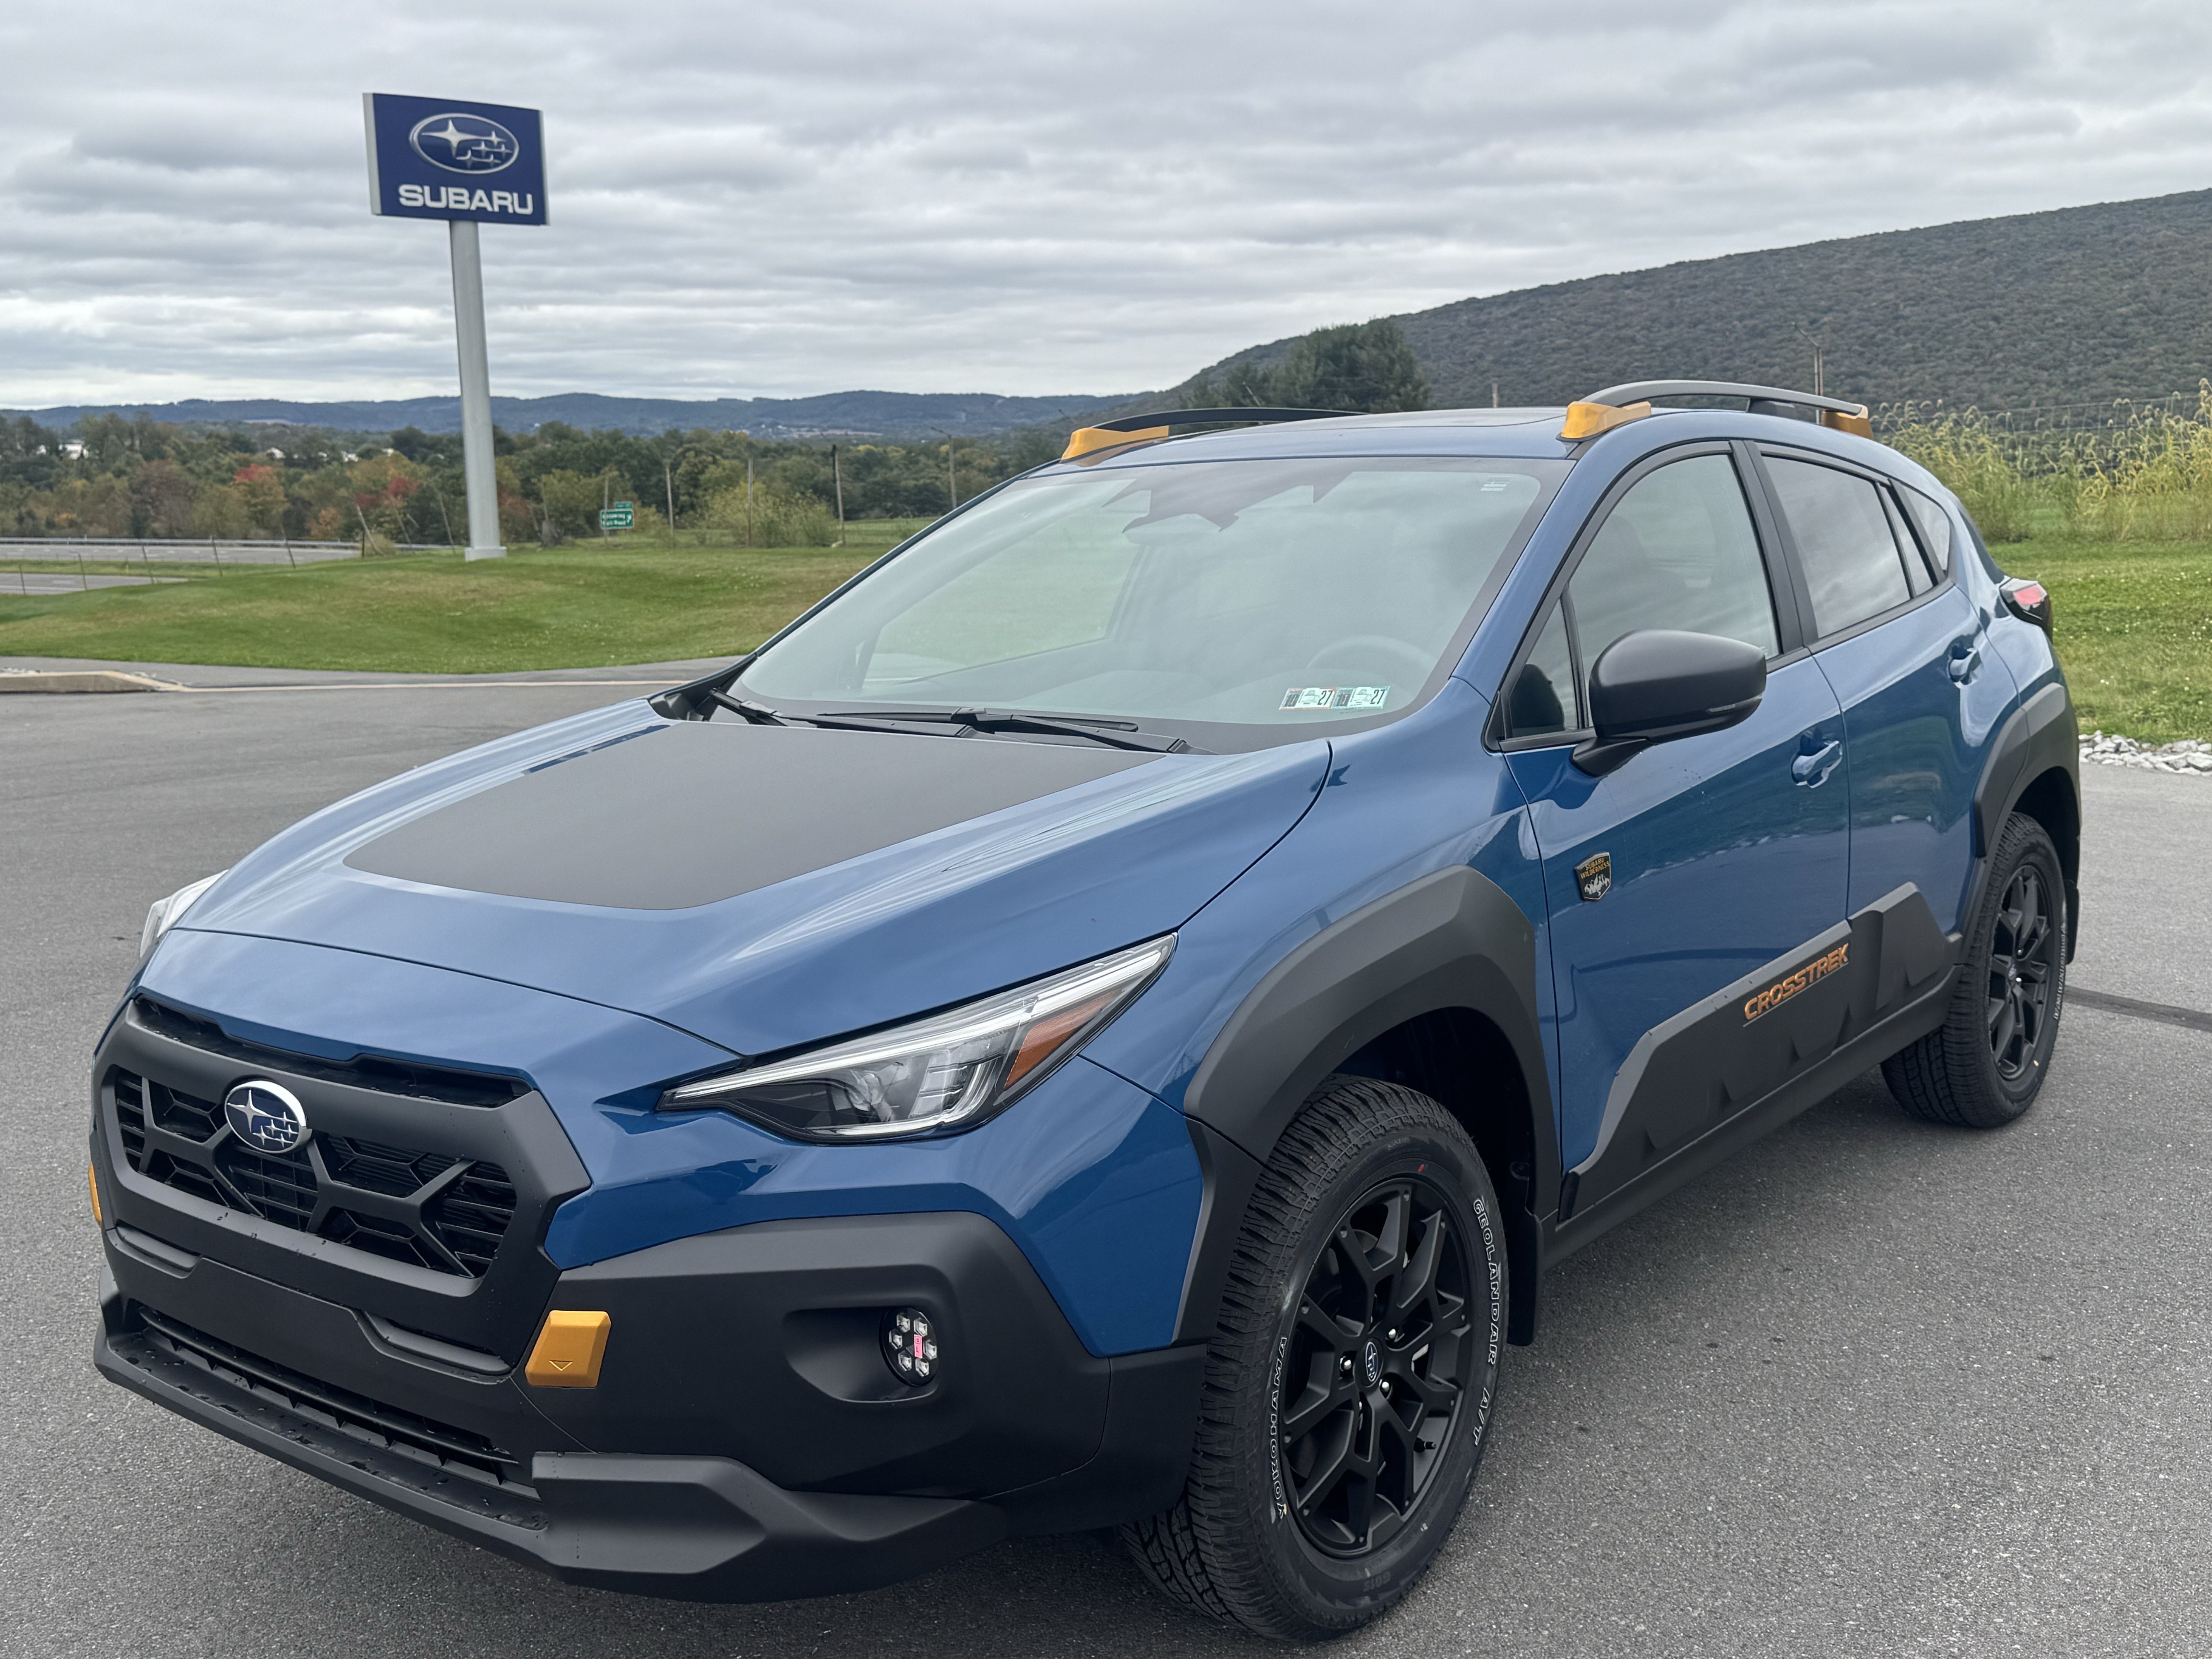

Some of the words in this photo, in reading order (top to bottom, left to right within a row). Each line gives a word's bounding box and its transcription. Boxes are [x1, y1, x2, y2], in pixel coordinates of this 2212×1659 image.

[398, 184, 533, 215] SUBARU
[1317, 690, 1333, 706] 27
[1370, 689, 1386, 704] 27
[1745, 943, 1849, 1020] CROSSTREK
[1473, 1199, 1499, 1365] GEOLANDAR
[1270, 1337, 1287, 1520] YOKOHAMA
[1473, 1387, 1490, 1446] A/T
